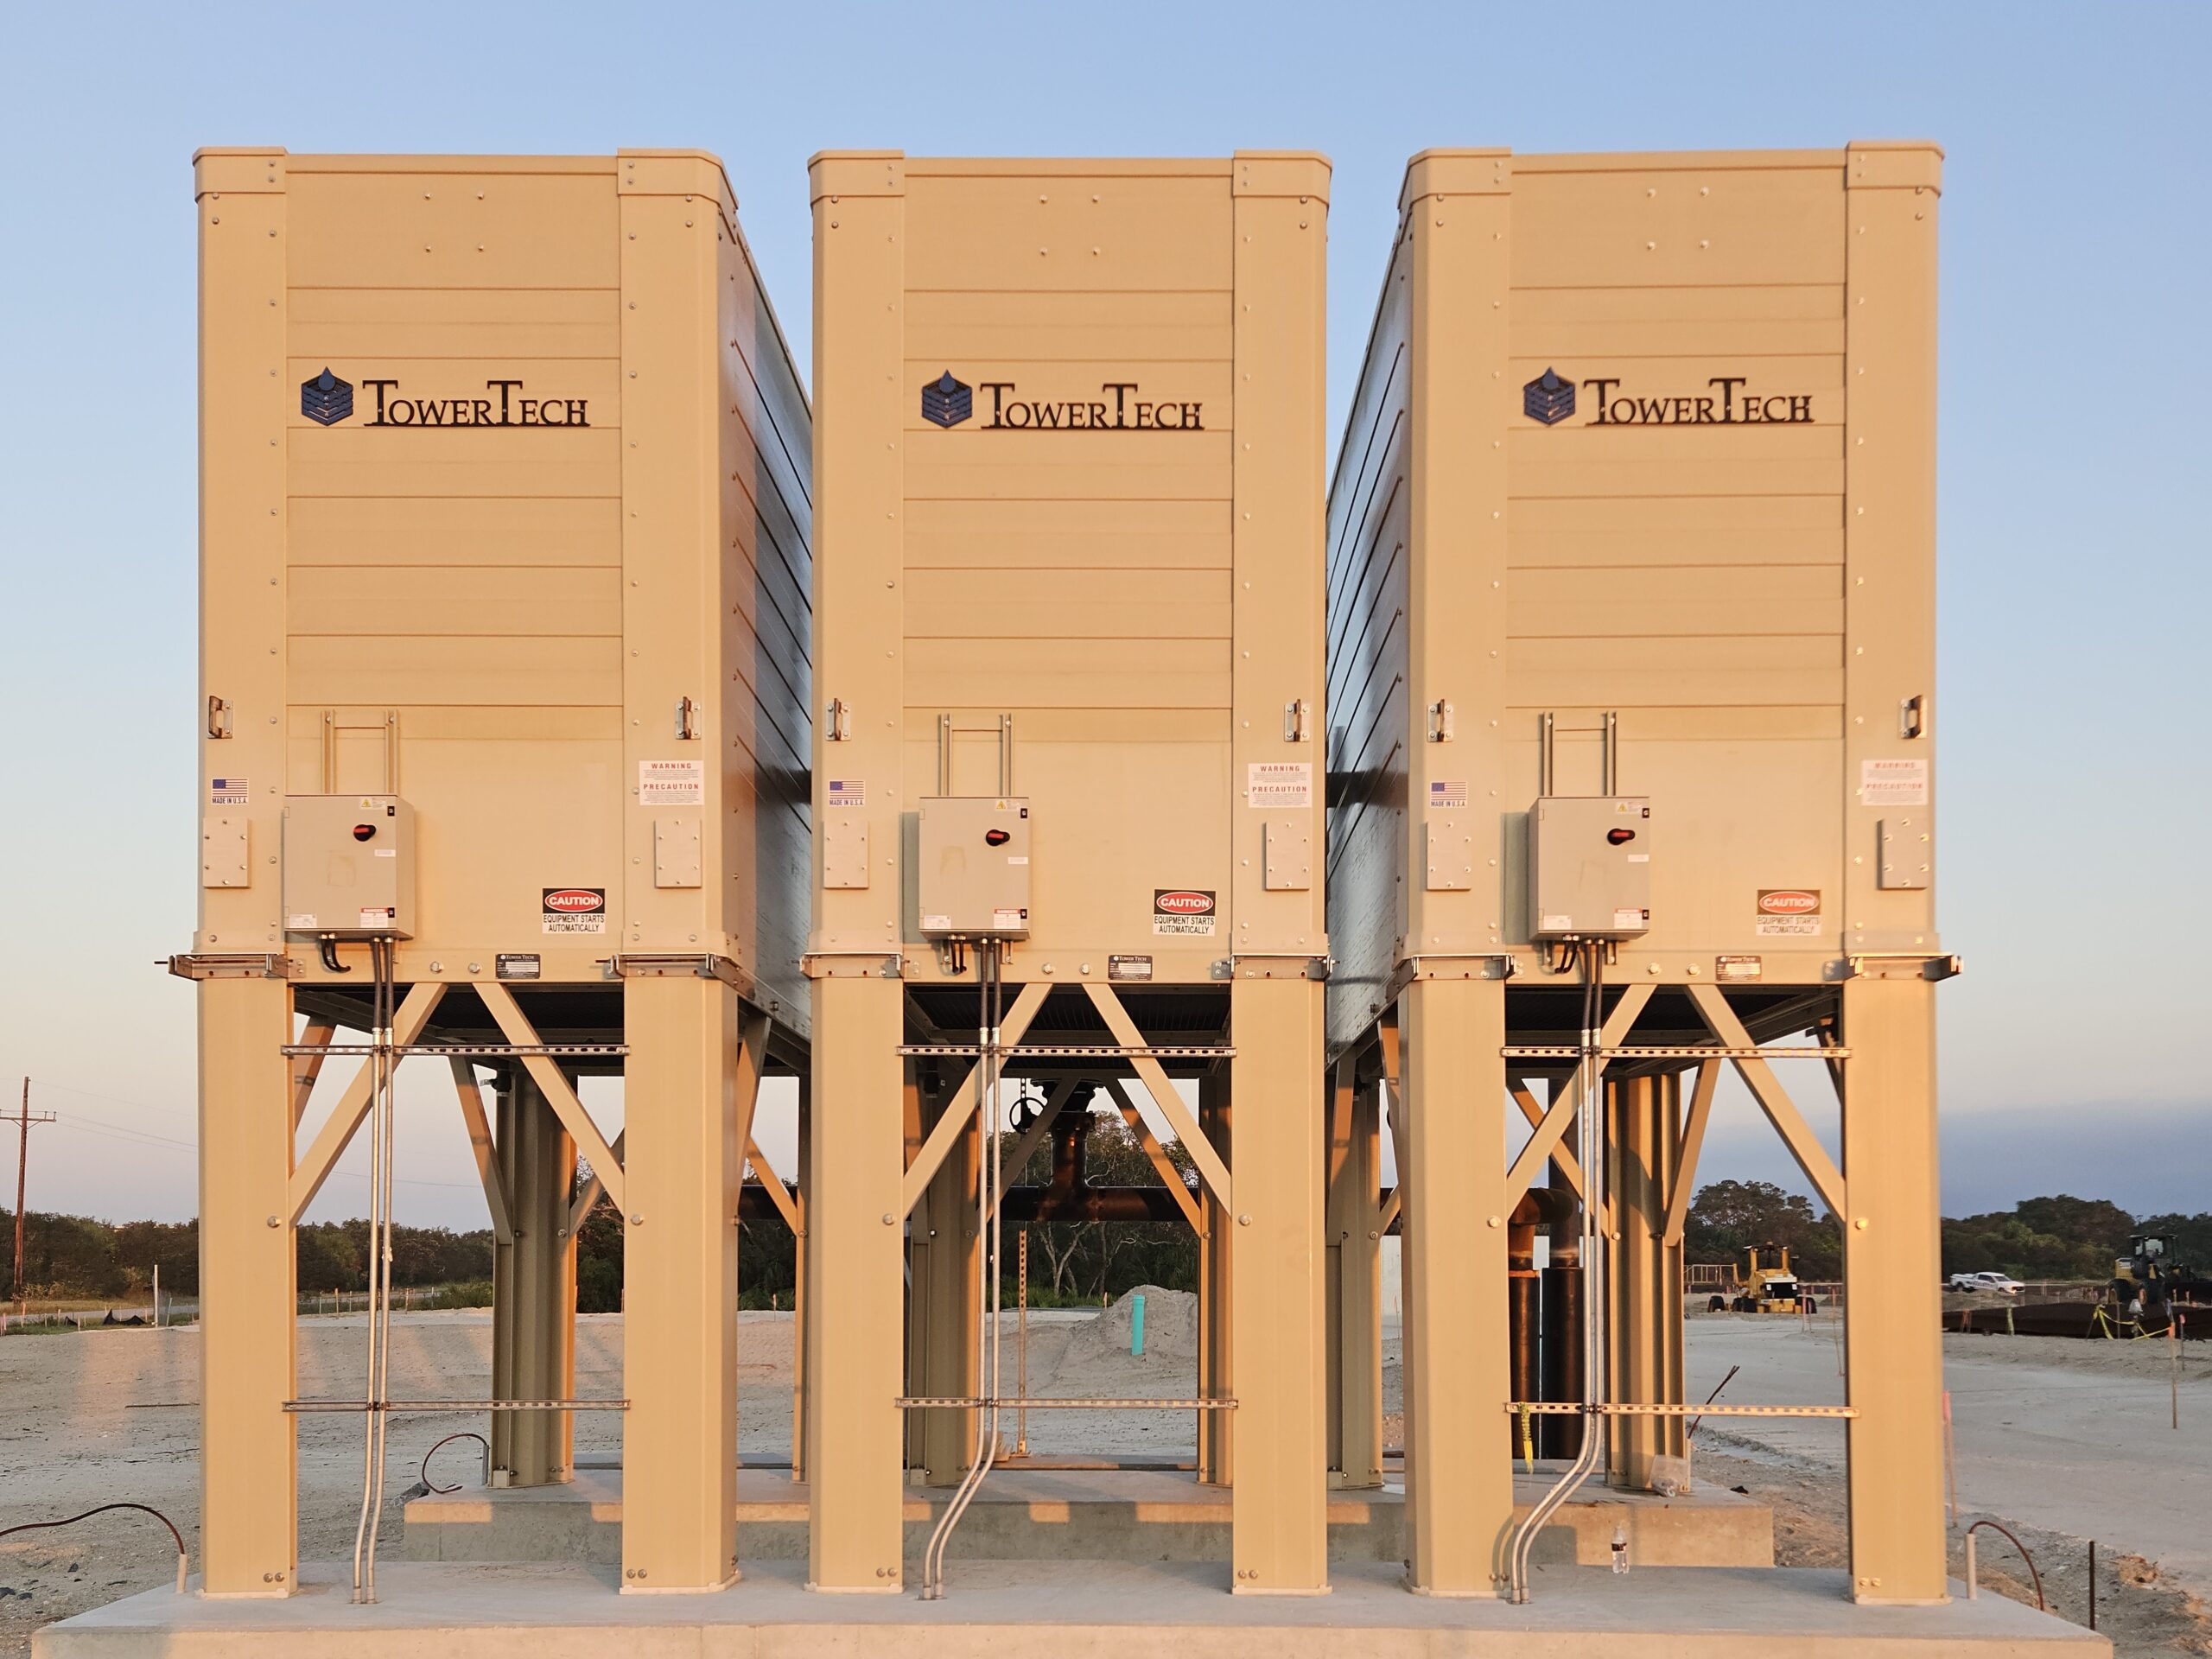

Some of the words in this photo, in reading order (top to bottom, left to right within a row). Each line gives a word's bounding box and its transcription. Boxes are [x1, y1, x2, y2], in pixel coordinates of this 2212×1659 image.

[362, 379, 590, 427] TOWERTECH
[980, 383, 1205, 429] TOWERTECH
[1584, 378, 1815, 425] TOWERTECH
[549, 896, 600, 906] CAUTION
[1160, 898, 1211, 907] CAUTION
[1763, 897, 1815, 907] CAUTION
[543, 914, 579, 923] EQUIPMENT
[581, 914, 604, 923] STARTS
[1154, 916, 1190, 925] EQUIPMENT
[549, 924, 600, 932] AUTOMATICALLY
[1159, 925, 1209, 934] AUTOMATICALLY
